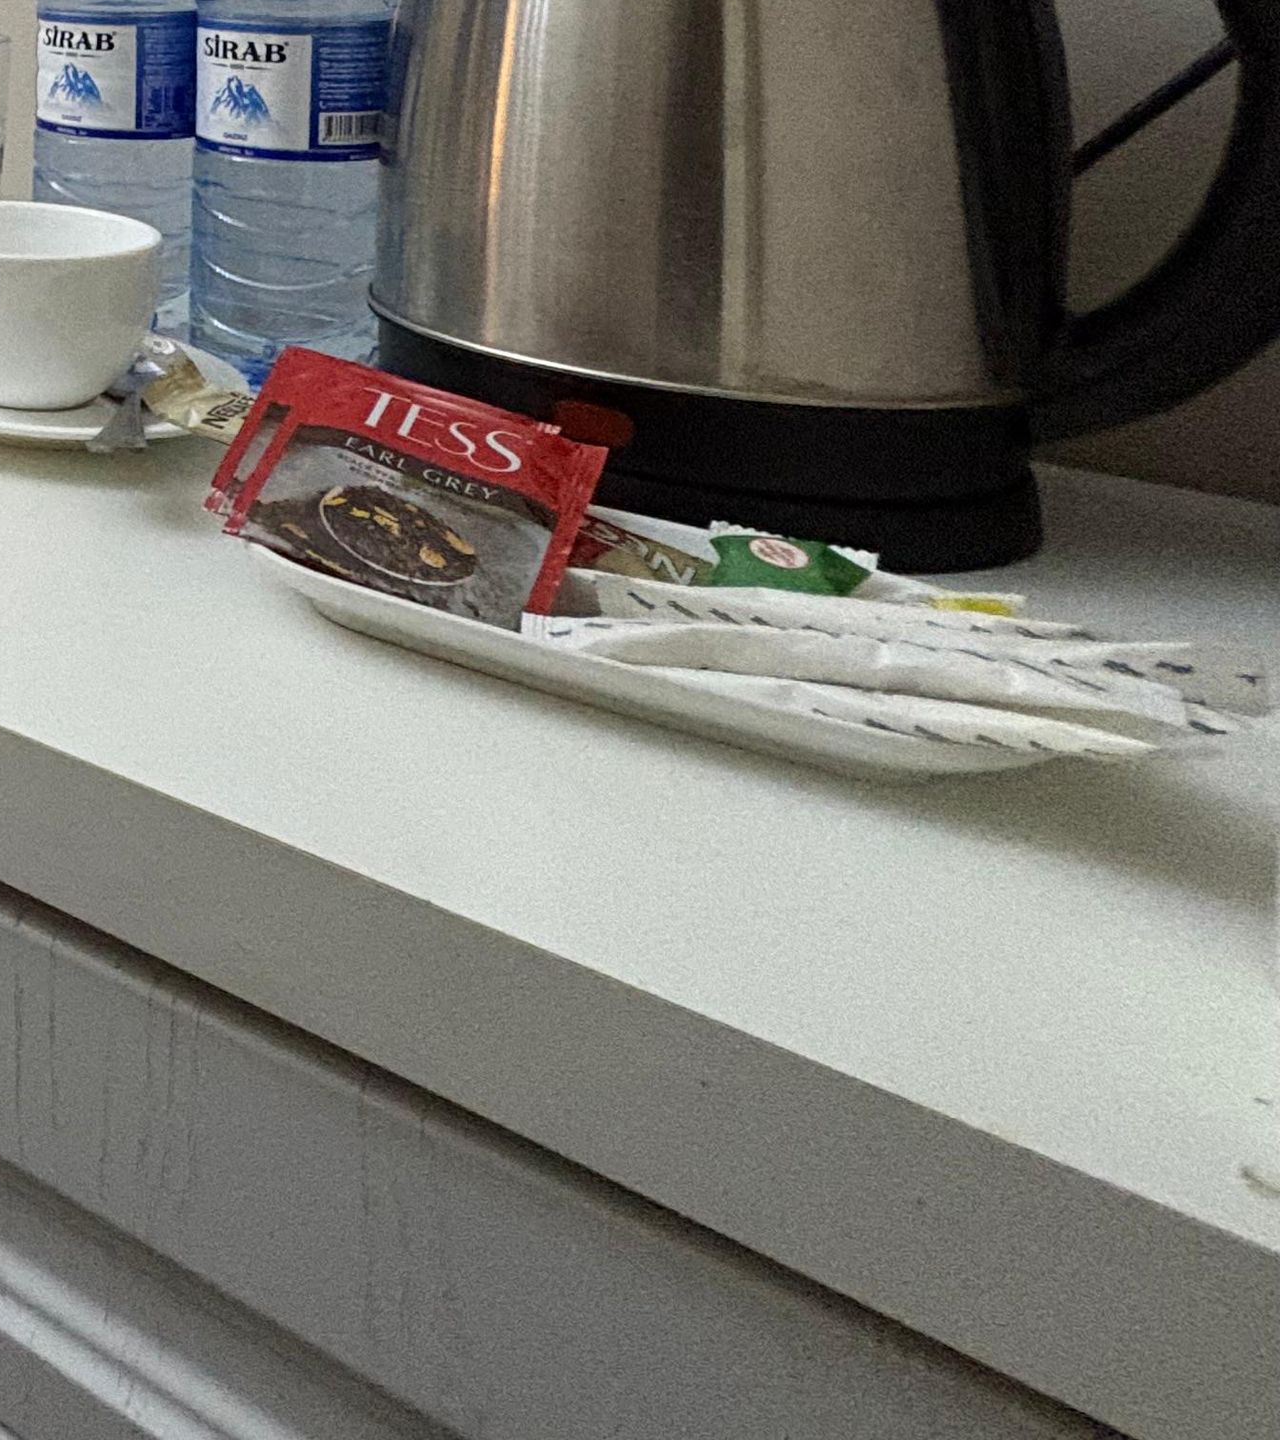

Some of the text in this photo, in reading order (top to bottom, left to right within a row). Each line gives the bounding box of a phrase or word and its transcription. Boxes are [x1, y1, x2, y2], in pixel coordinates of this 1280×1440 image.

[43, 26, 115, 52] SİRAB
[204, 34, 287, 64] SİRAB
[363, 387, 522, 472] TESS
[344, 436, 407, 471] EARL
[422, 469, 500, 500] GREY
